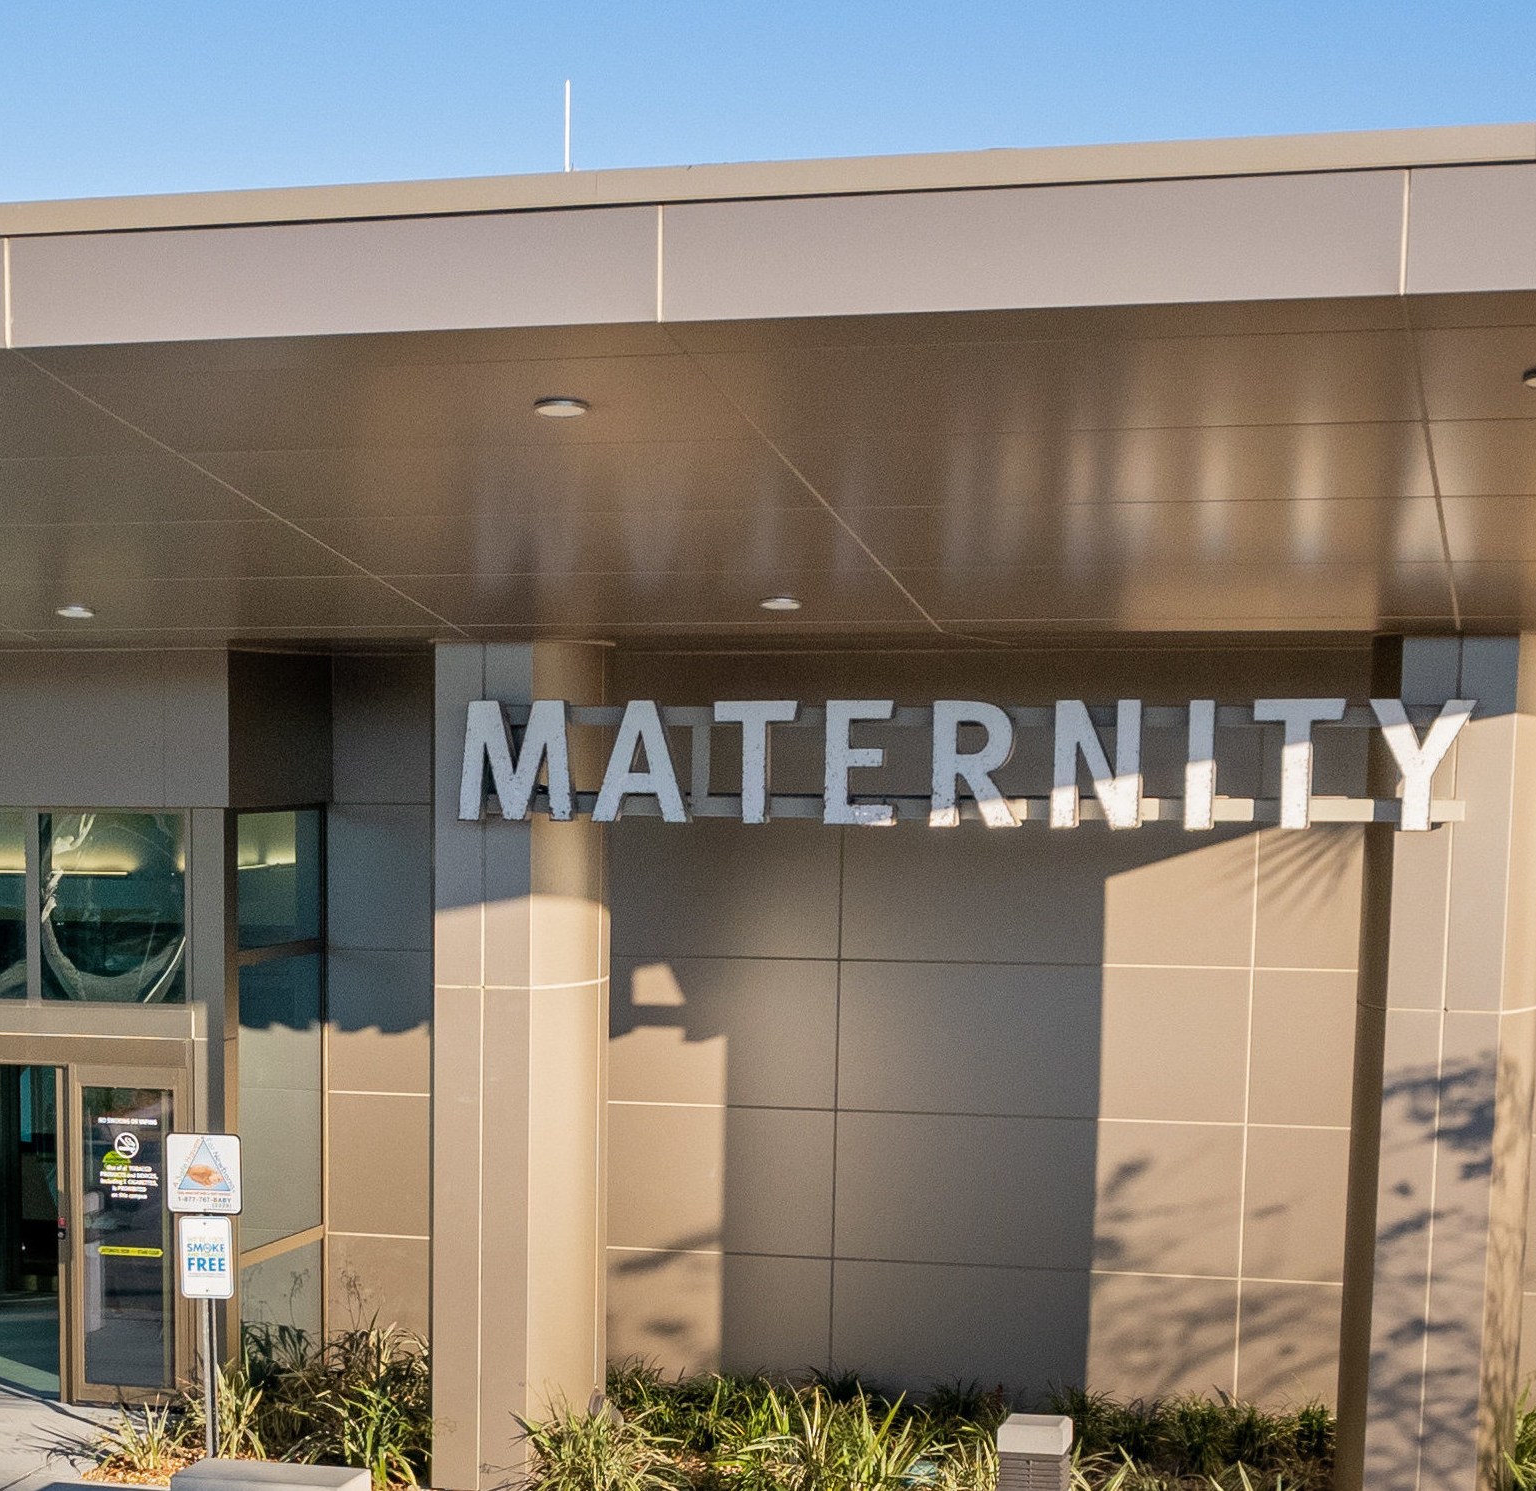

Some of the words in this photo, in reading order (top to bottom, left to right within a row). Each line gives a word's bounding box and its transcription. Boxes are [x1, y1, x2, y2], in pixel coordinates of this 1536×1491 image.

[458, 698, 1477, 832] MATERNITY
[187, 1243, 225, 1252] SMOKE
[188, 1257, 226, 1271] FREE
